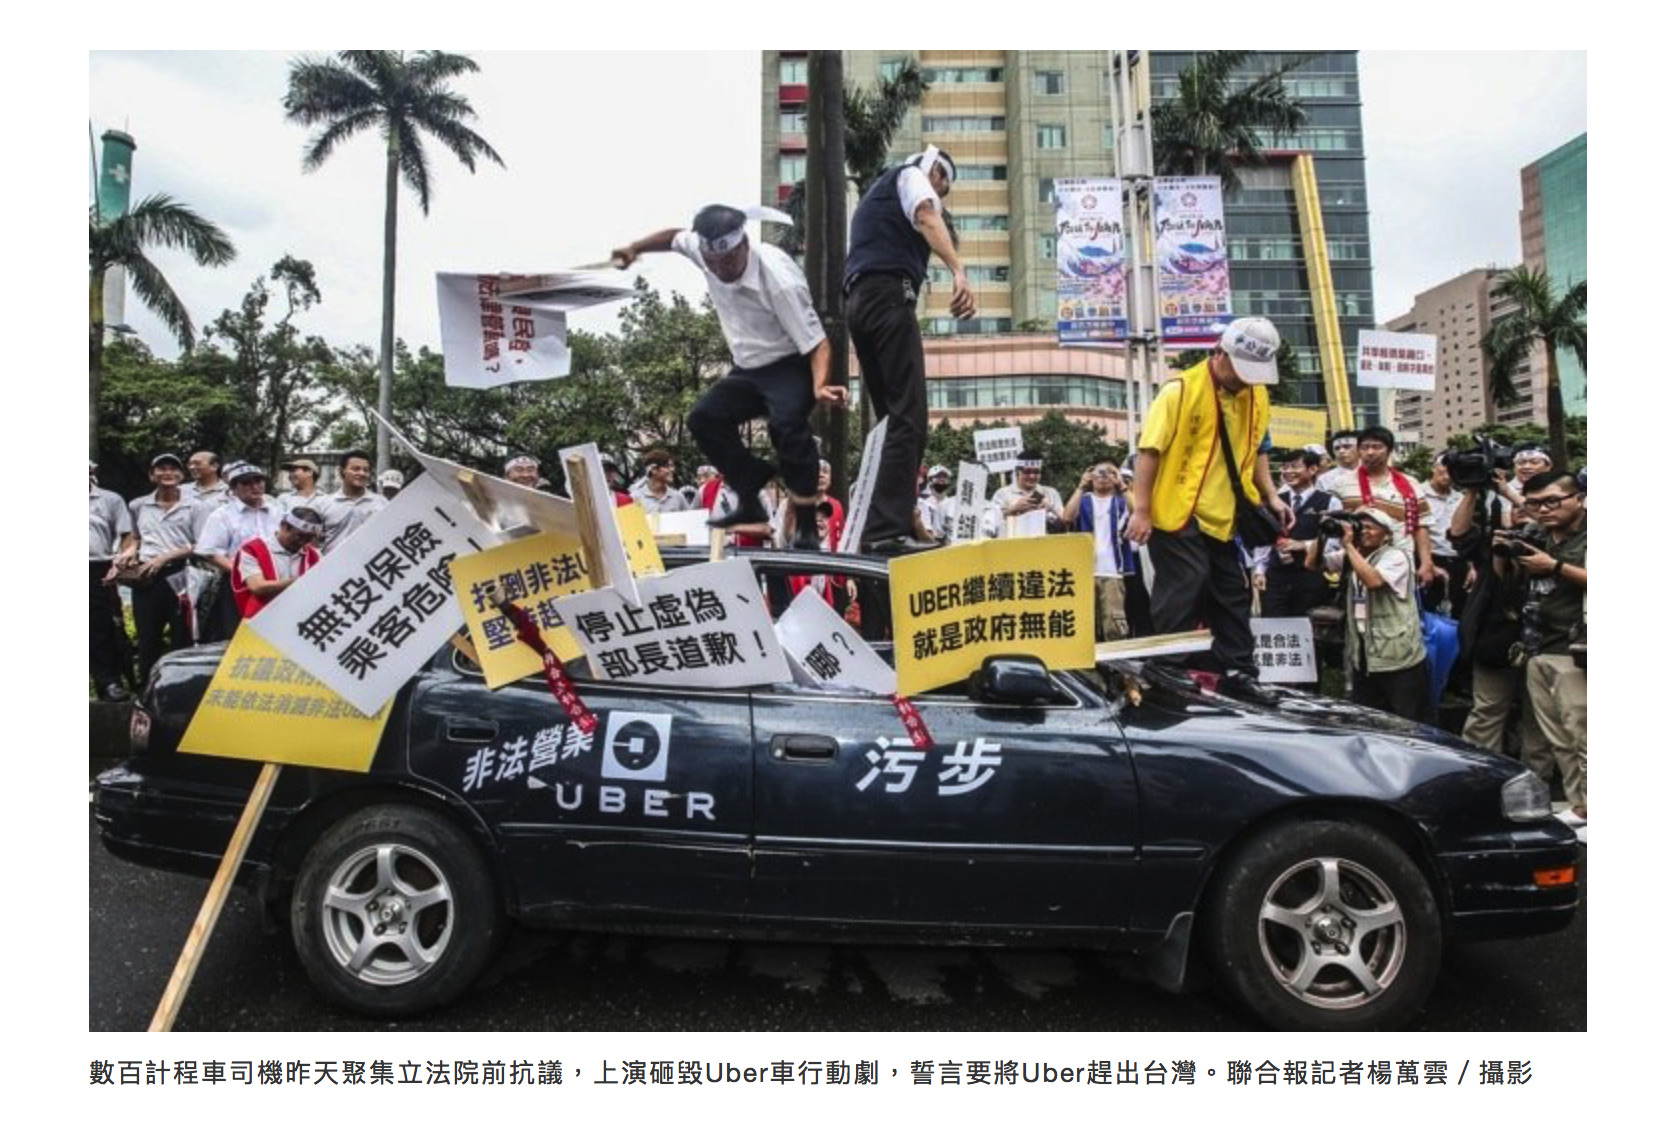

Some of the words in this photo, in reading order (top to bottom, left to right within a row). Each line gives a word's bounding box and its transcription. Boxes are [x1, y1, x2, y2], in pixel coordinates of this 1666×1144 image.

[297, 505, 458, 652] 無投保險！
[909, 568, 1076, 618] UBER繼續違法
[597, 630, 768, 681] 部長道歉！
[912, 610, 1077, 661] 就是政府無能
[462, 721, 594, 793] 非法營業
[556, 783, 716, 821] UBER
